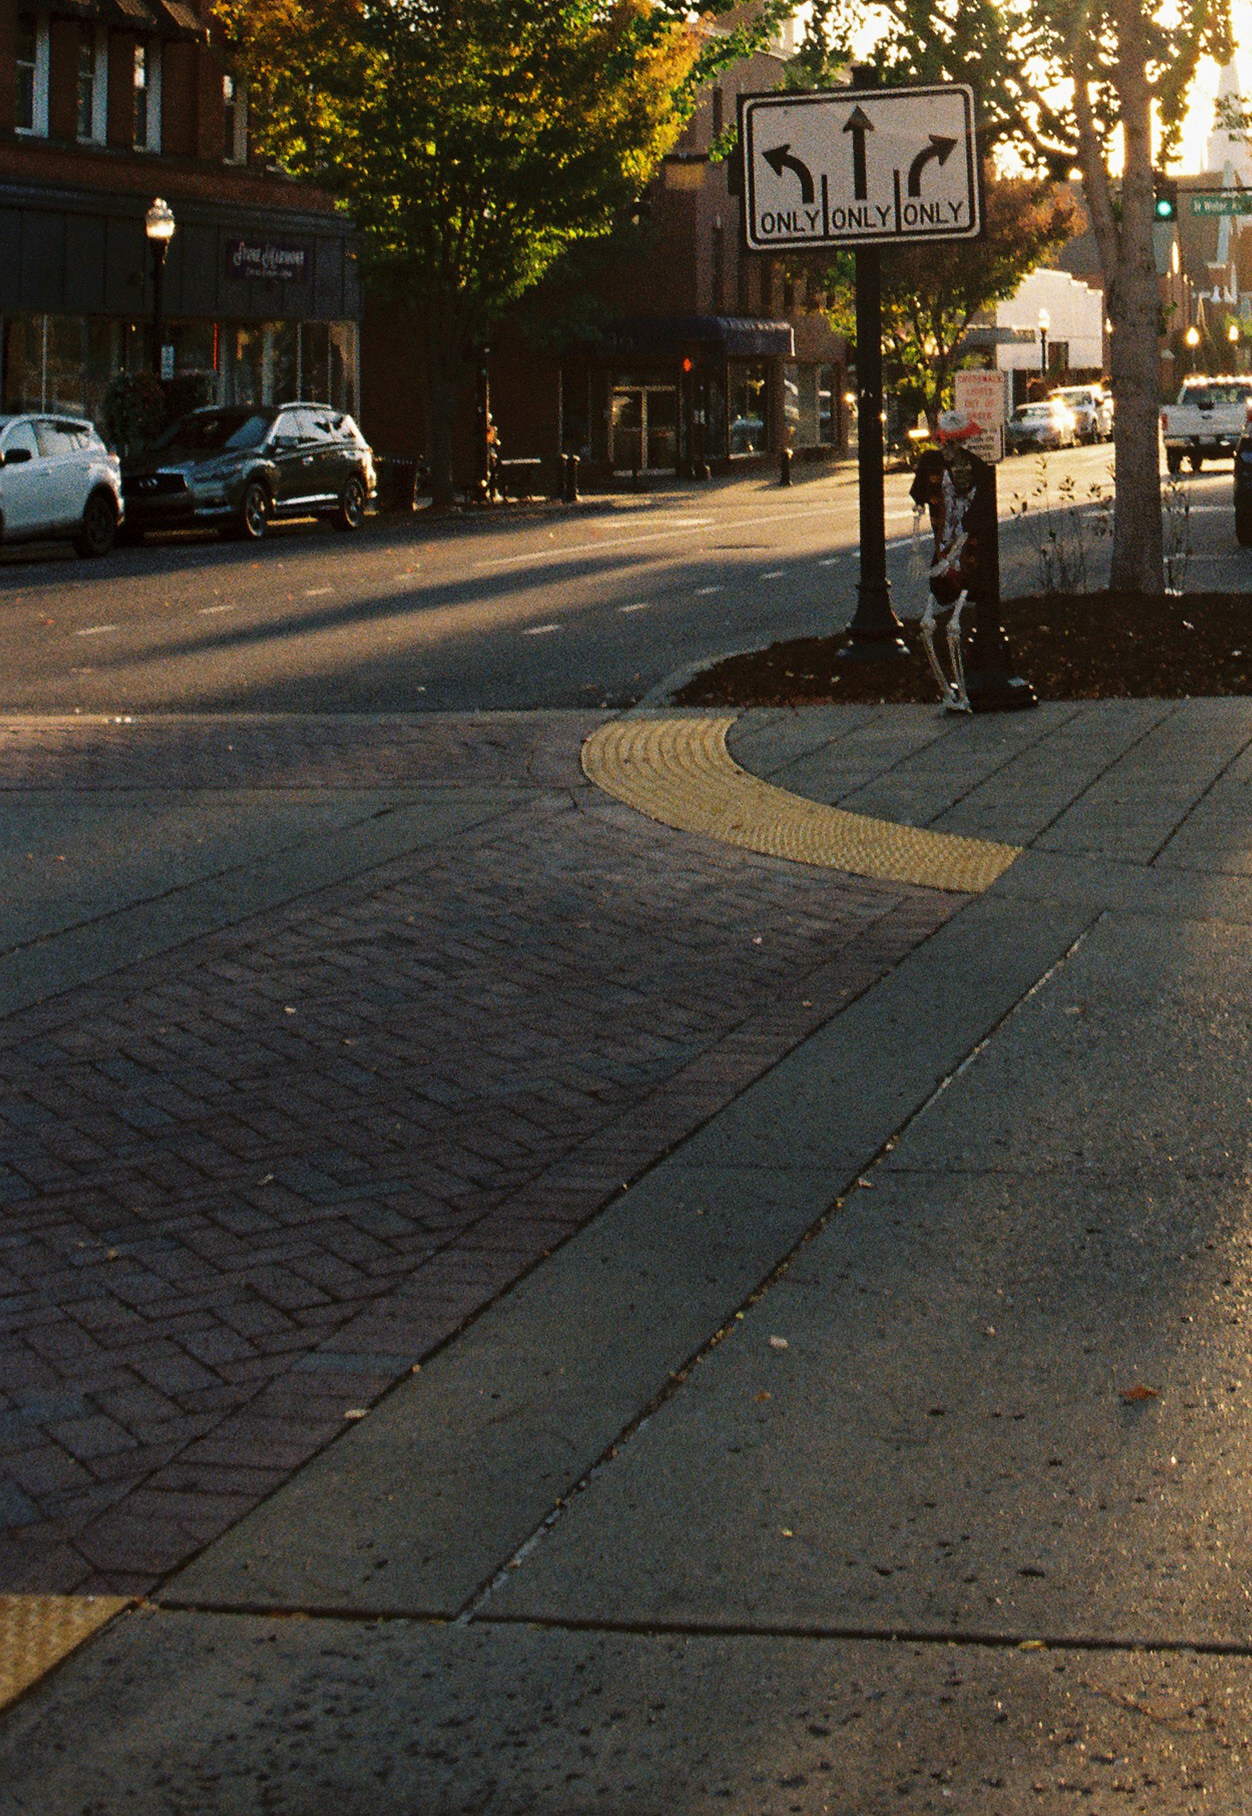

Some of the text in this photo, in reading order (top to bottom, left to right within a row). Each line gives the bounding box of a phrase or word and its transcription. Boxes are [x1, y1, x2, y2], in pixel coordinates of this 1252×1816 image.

[761, 201, 963, 234] ONLY ONLY ONLY
